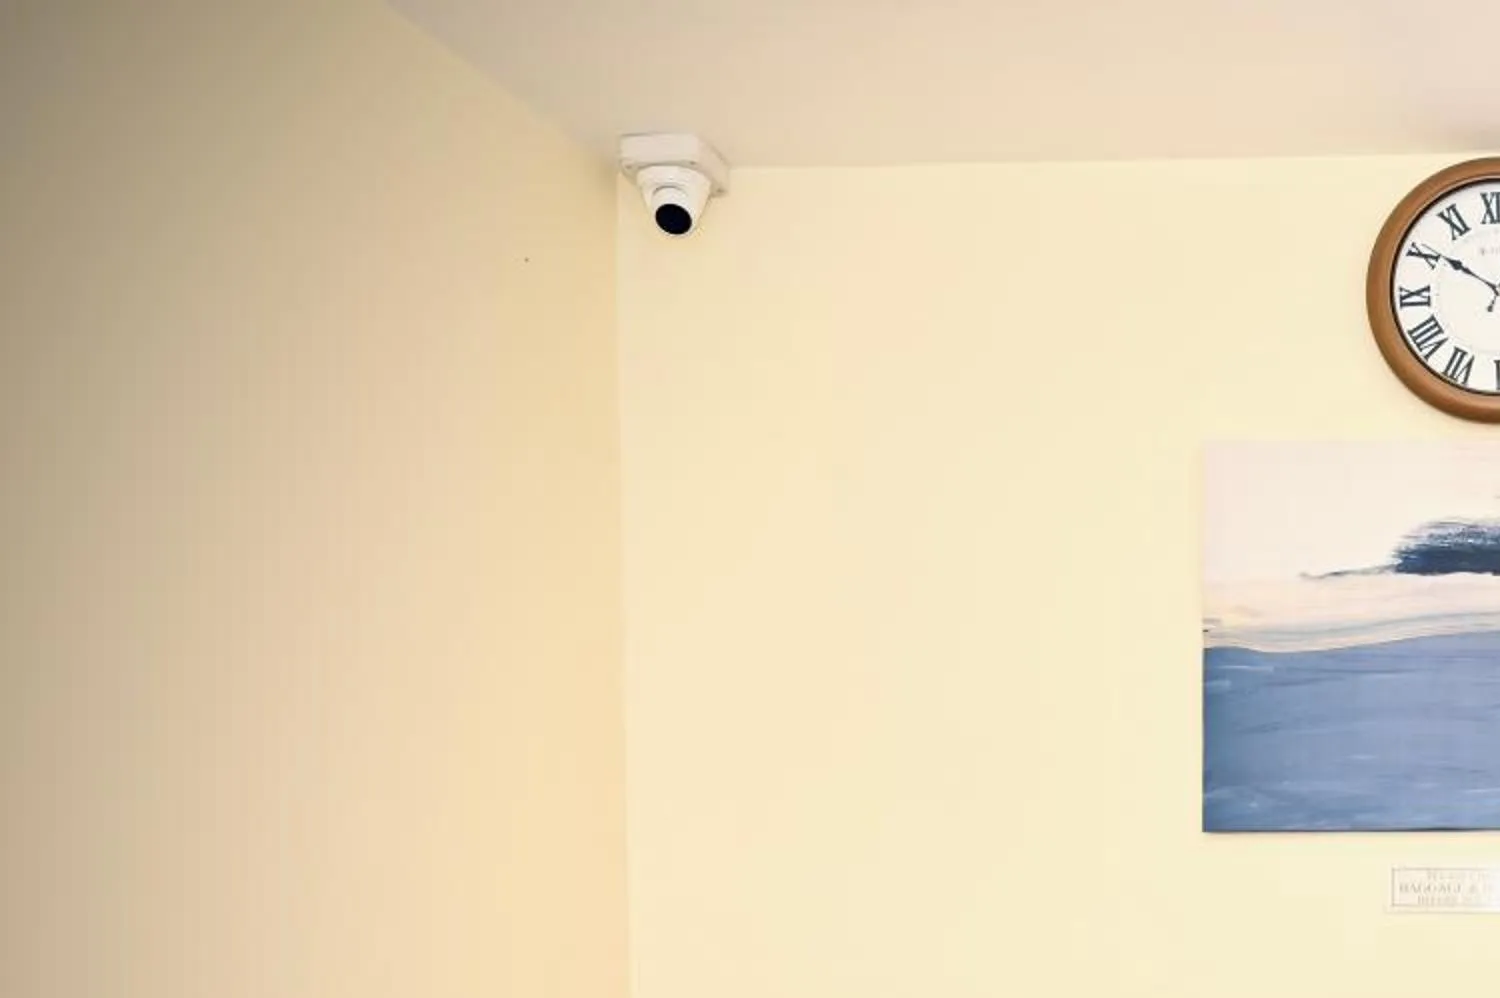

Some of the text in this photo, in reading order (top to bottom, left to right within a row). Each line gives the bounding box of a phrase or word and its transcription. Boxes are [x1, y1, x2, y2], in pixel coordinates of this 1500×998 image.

[1437, 203, 1471, 240] XI
[1406, 242, 1441, 269] X
[1399, 285, 1431, 308] IX
[1408, 315, 1448, 361] VIII
[1444, 346, 1475, 387] VII
